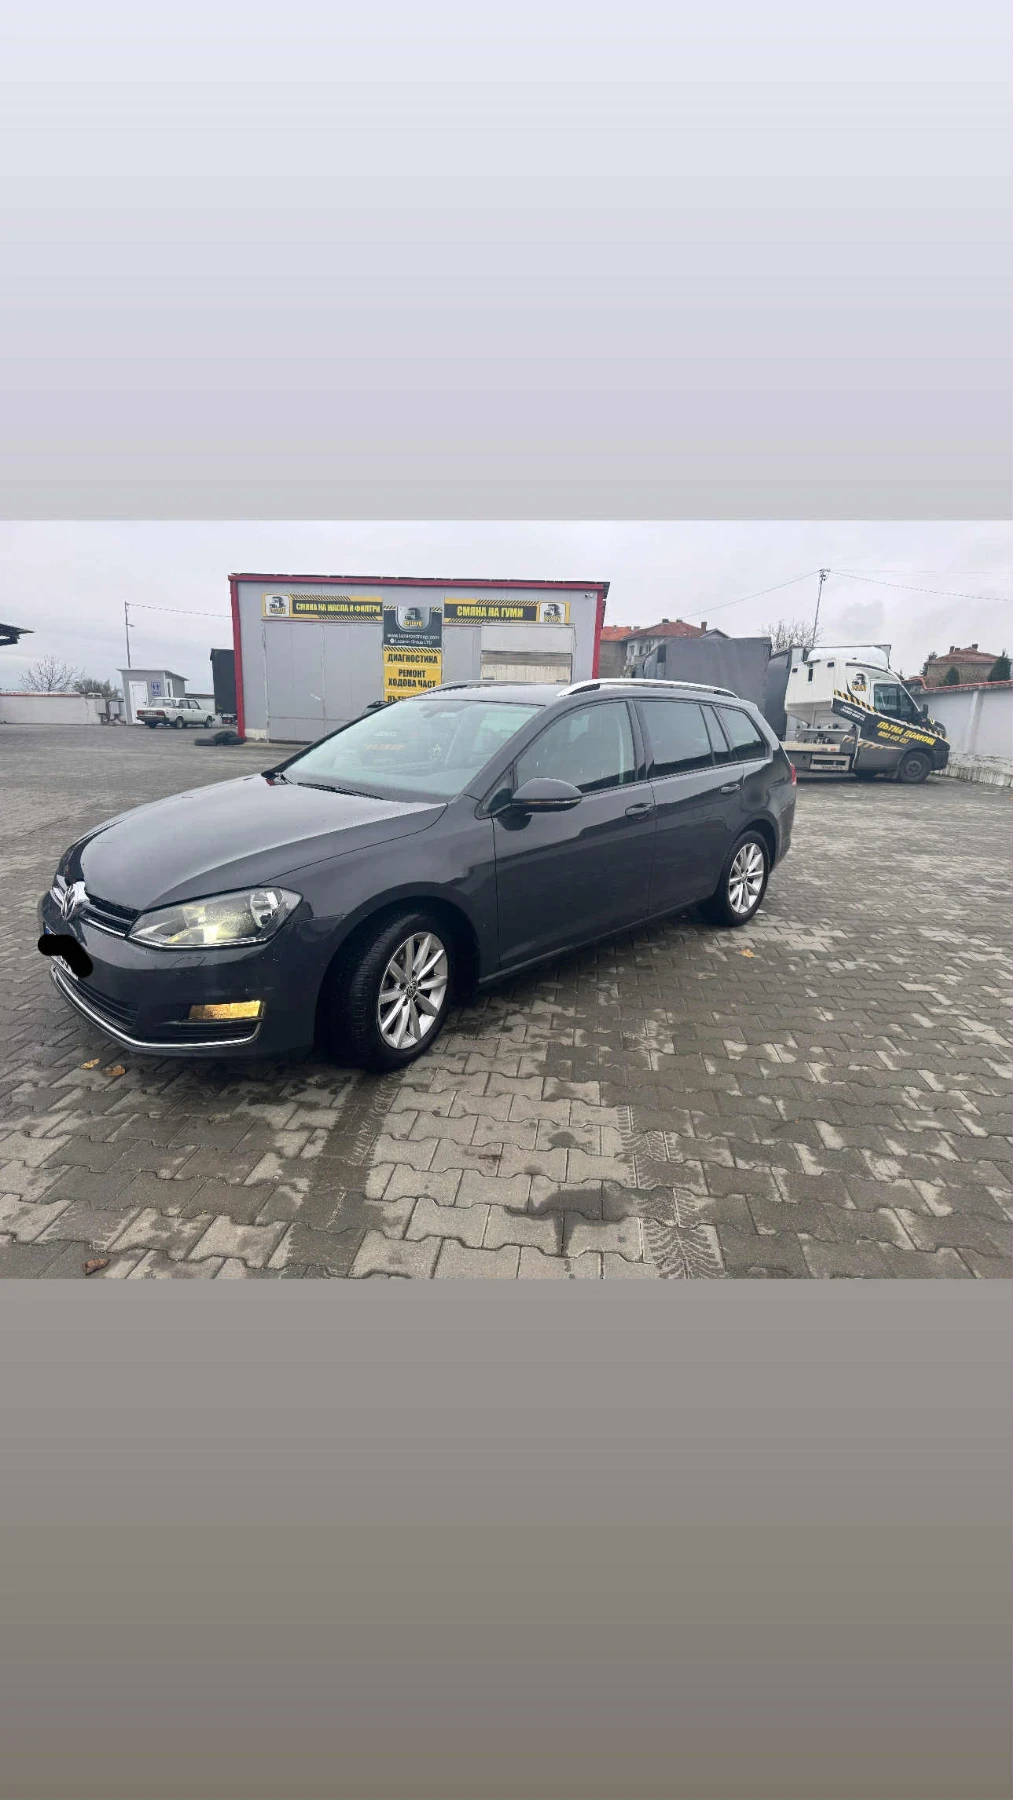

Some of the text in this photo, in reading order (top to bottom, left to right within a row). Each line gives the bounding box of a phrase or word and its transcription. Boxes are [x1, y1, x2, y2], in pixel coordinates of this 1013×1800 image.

[319, 603, 326, 611] НА
[457, 606, 524, 618] СМЯНА НА ГУМИ
[388, 654, 438, 664] ДИАГНОСТИКА
[398, 669, 426, 678] РЕМОНТ
[388, 678, 436, 688] ХОДОВА ЧАСТ
[877, 722, 936, 746] ПЪТНА ПОМОЩ
